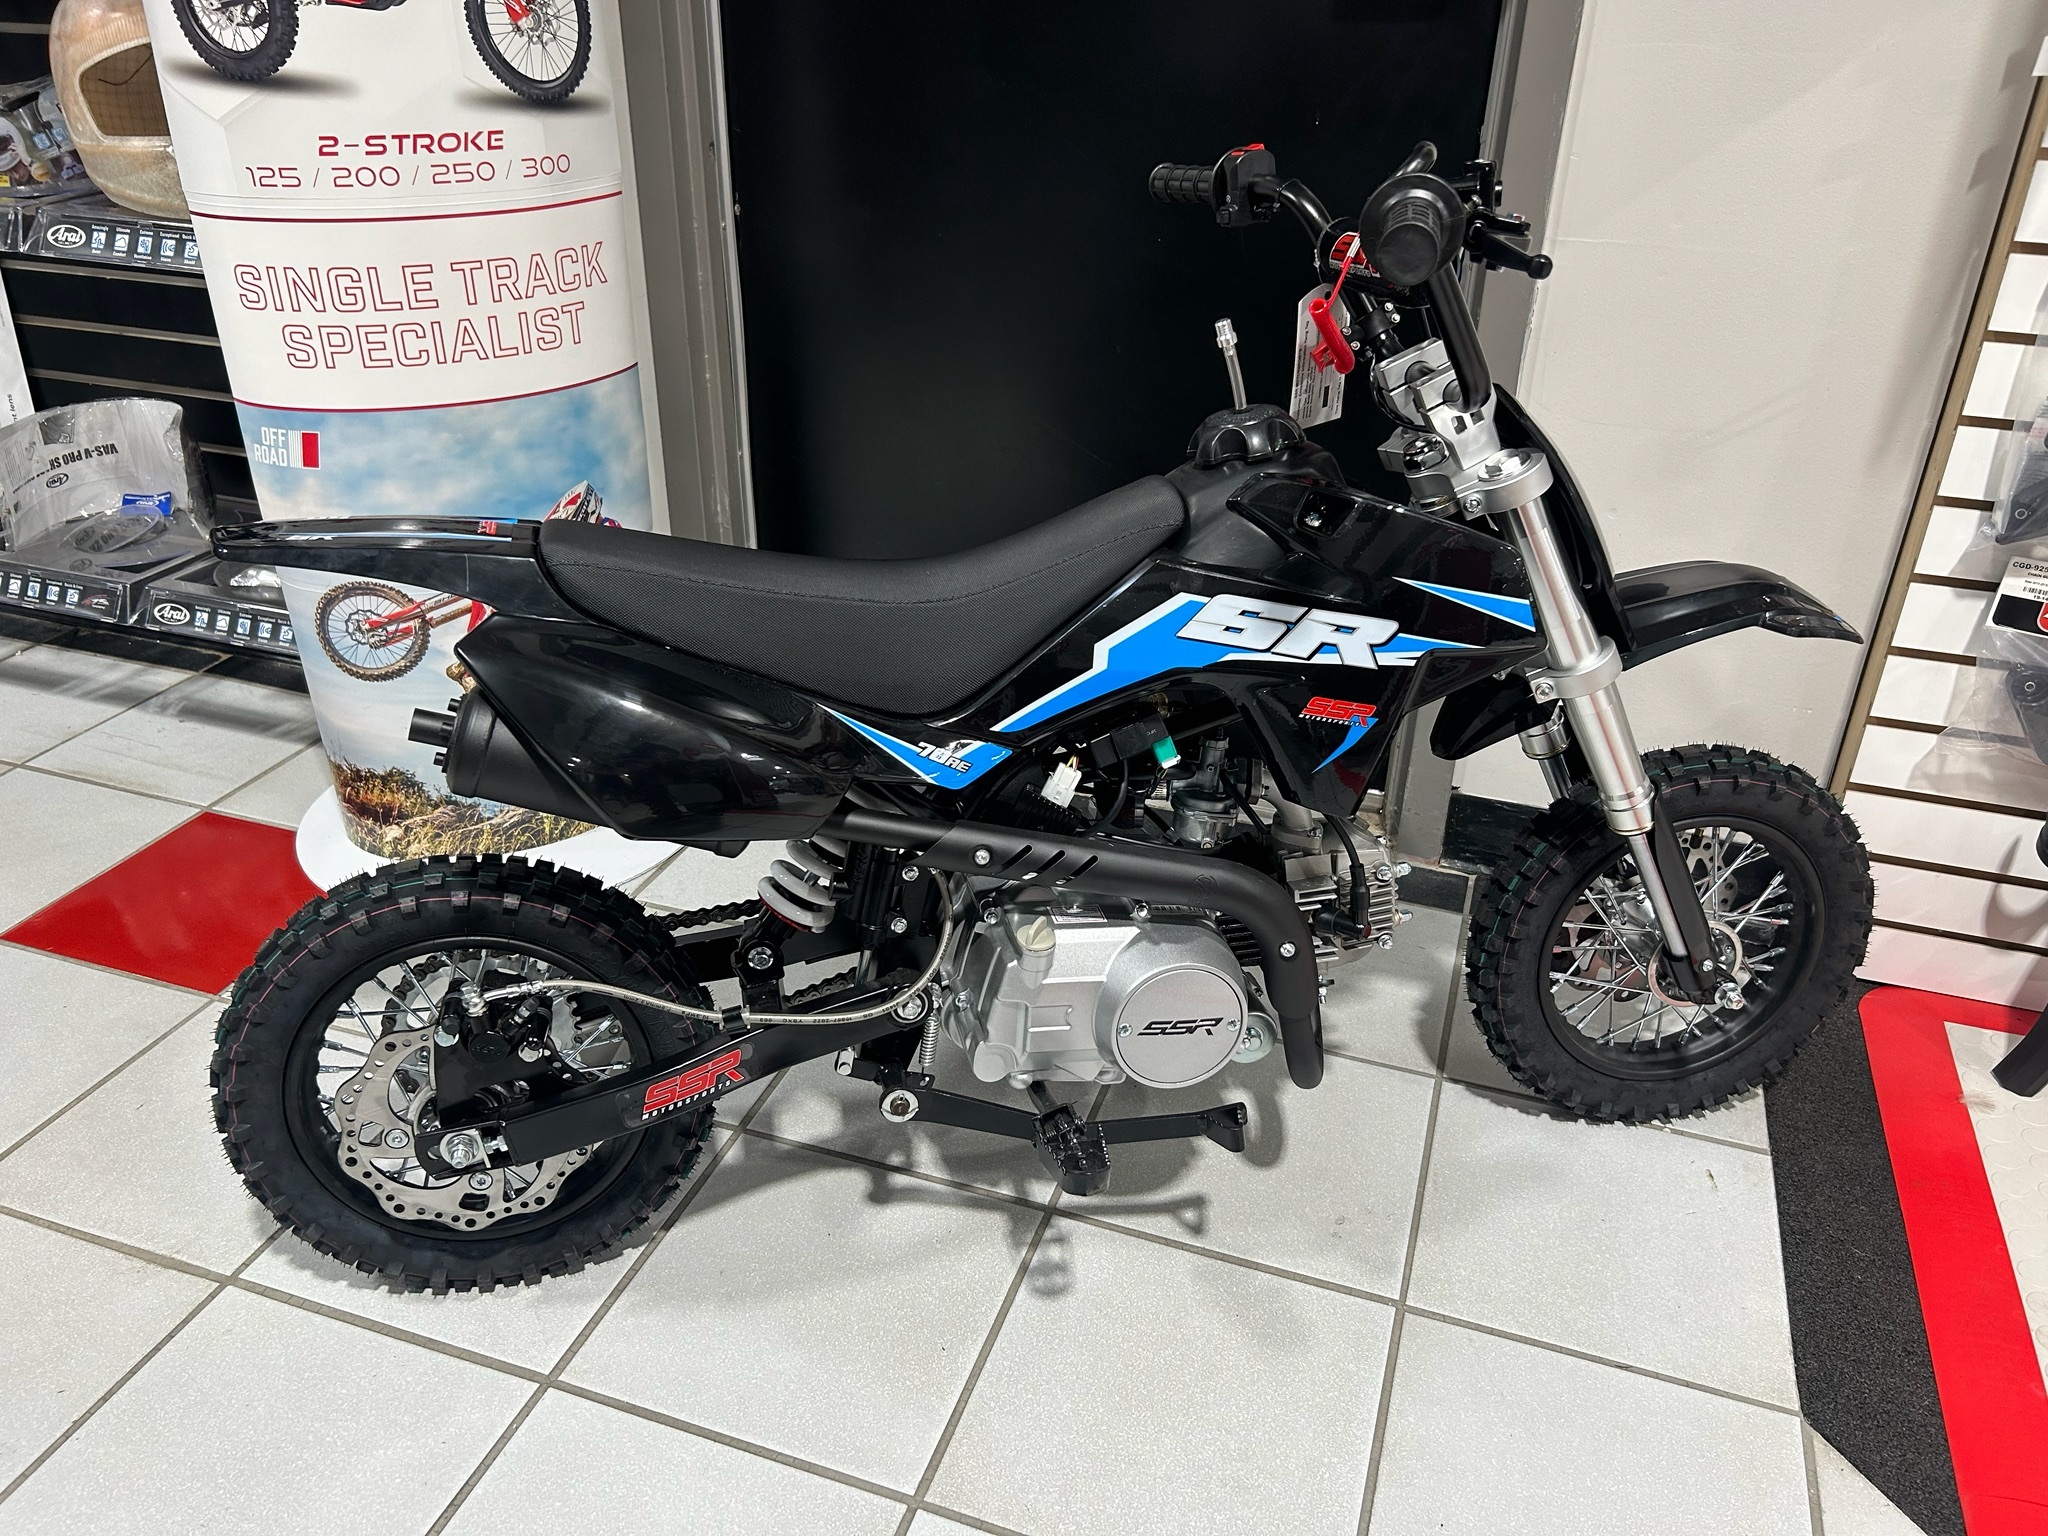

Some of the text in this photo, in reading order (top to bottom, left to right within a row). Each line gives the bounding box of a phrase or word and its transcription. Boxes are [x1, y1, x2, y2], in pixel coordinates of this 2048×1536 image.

[318, 129, 504, 157] 2-STROKE
[245, 153, 571, 188] 125 / 200 / 250 / 300
[51, 228, 84, 245] Arai
[233, 241, 608, 313] SINGLE TRACK
[282, 300, 586, 369] SPECIALIST
[261, 427, 287, 446] OFF
[63, 449, 83, 466] PRO
[84, 443, 119, 462] VAS-V
[254, 444, 289, 467] ROAD
[158, 605, 186, 622] Arai
[1175, 593, 1400, 670] SR
[1298, 714, 1360, 727] MOTORSPORTS
[1301, 696, 1377, 728] SSR
[1137, 1016, 1224, 1036] SSR
[643, 1048, 744, 1114] SSR
[641, 1080, 732, 1121] MOTORSPORTS
